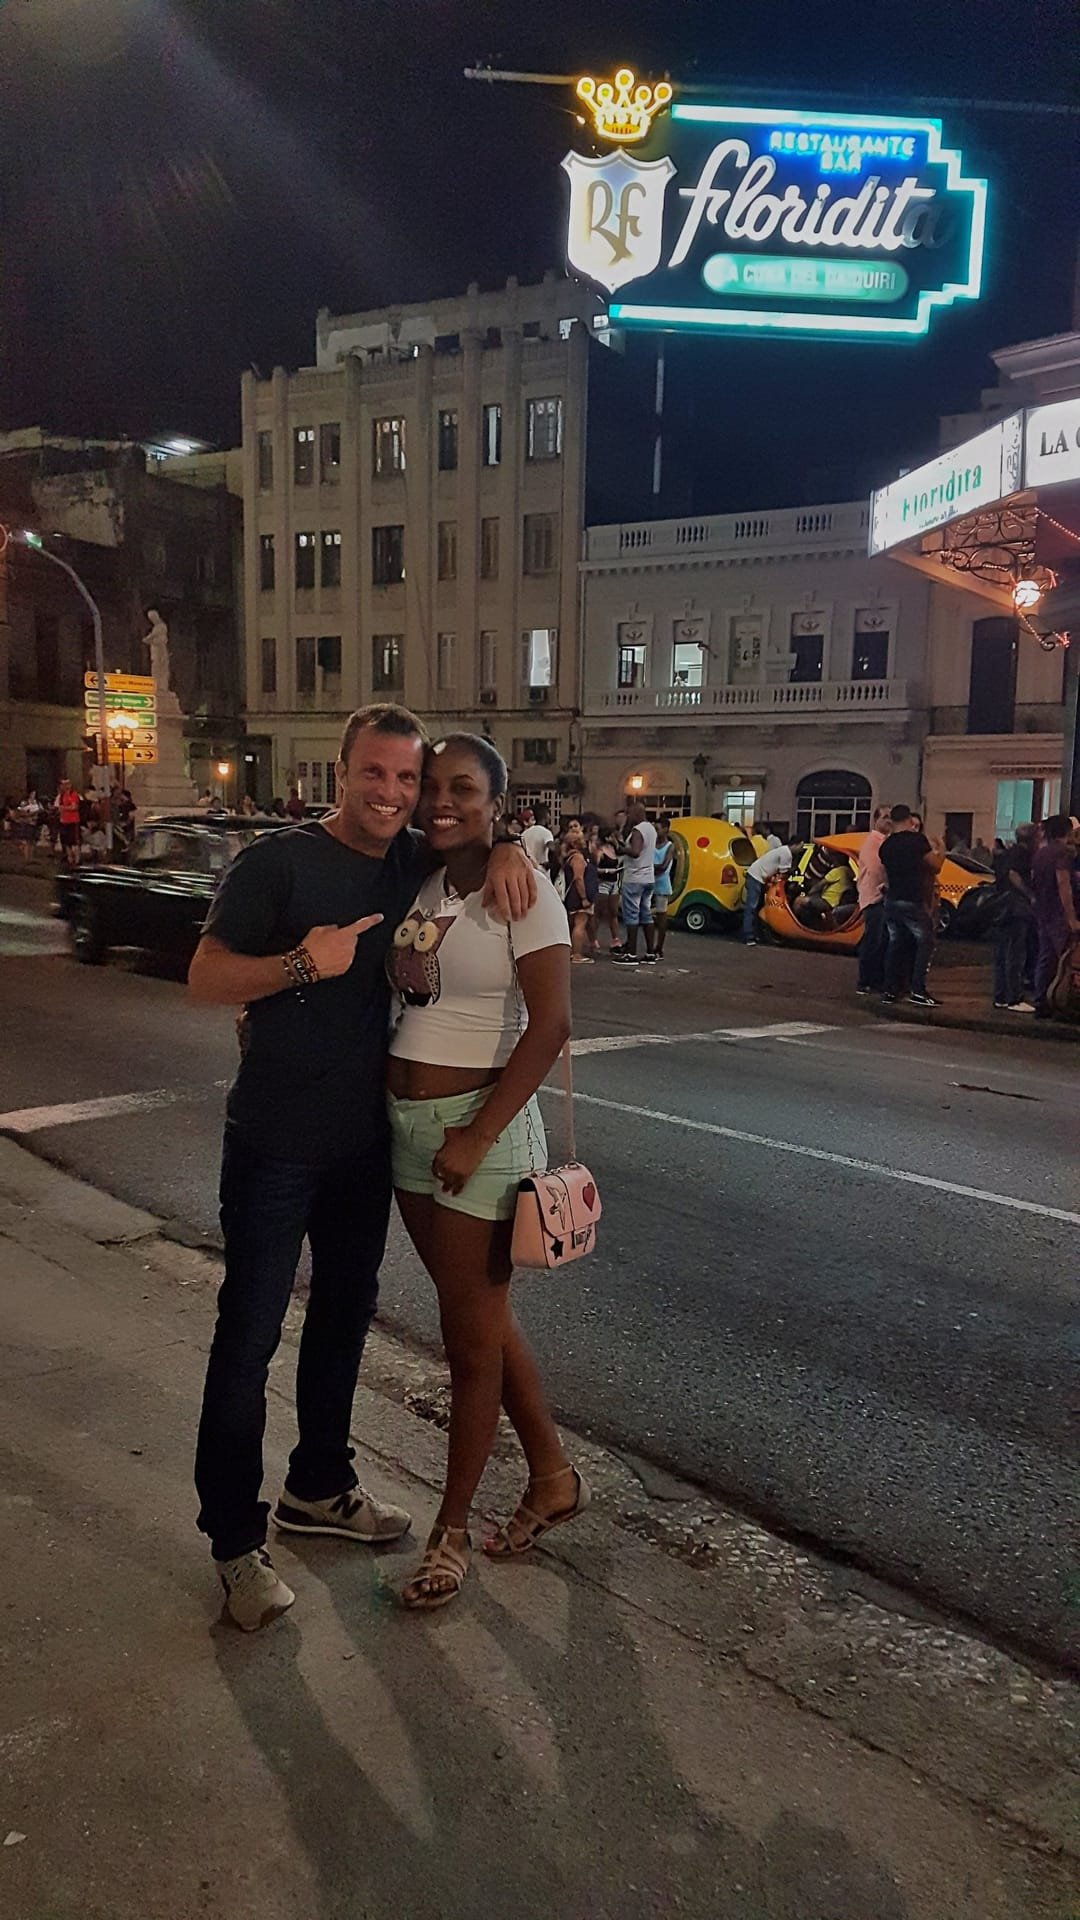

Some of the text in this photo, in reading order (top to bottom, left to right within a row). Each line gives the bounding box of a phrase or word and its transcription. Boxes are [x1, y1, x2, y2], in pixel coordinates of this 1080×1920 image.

[770, 131, 916, 156] RESTAURANTE
[820, 150, 862, 171] BAR
[1040, 429, 1069, 456] LA
